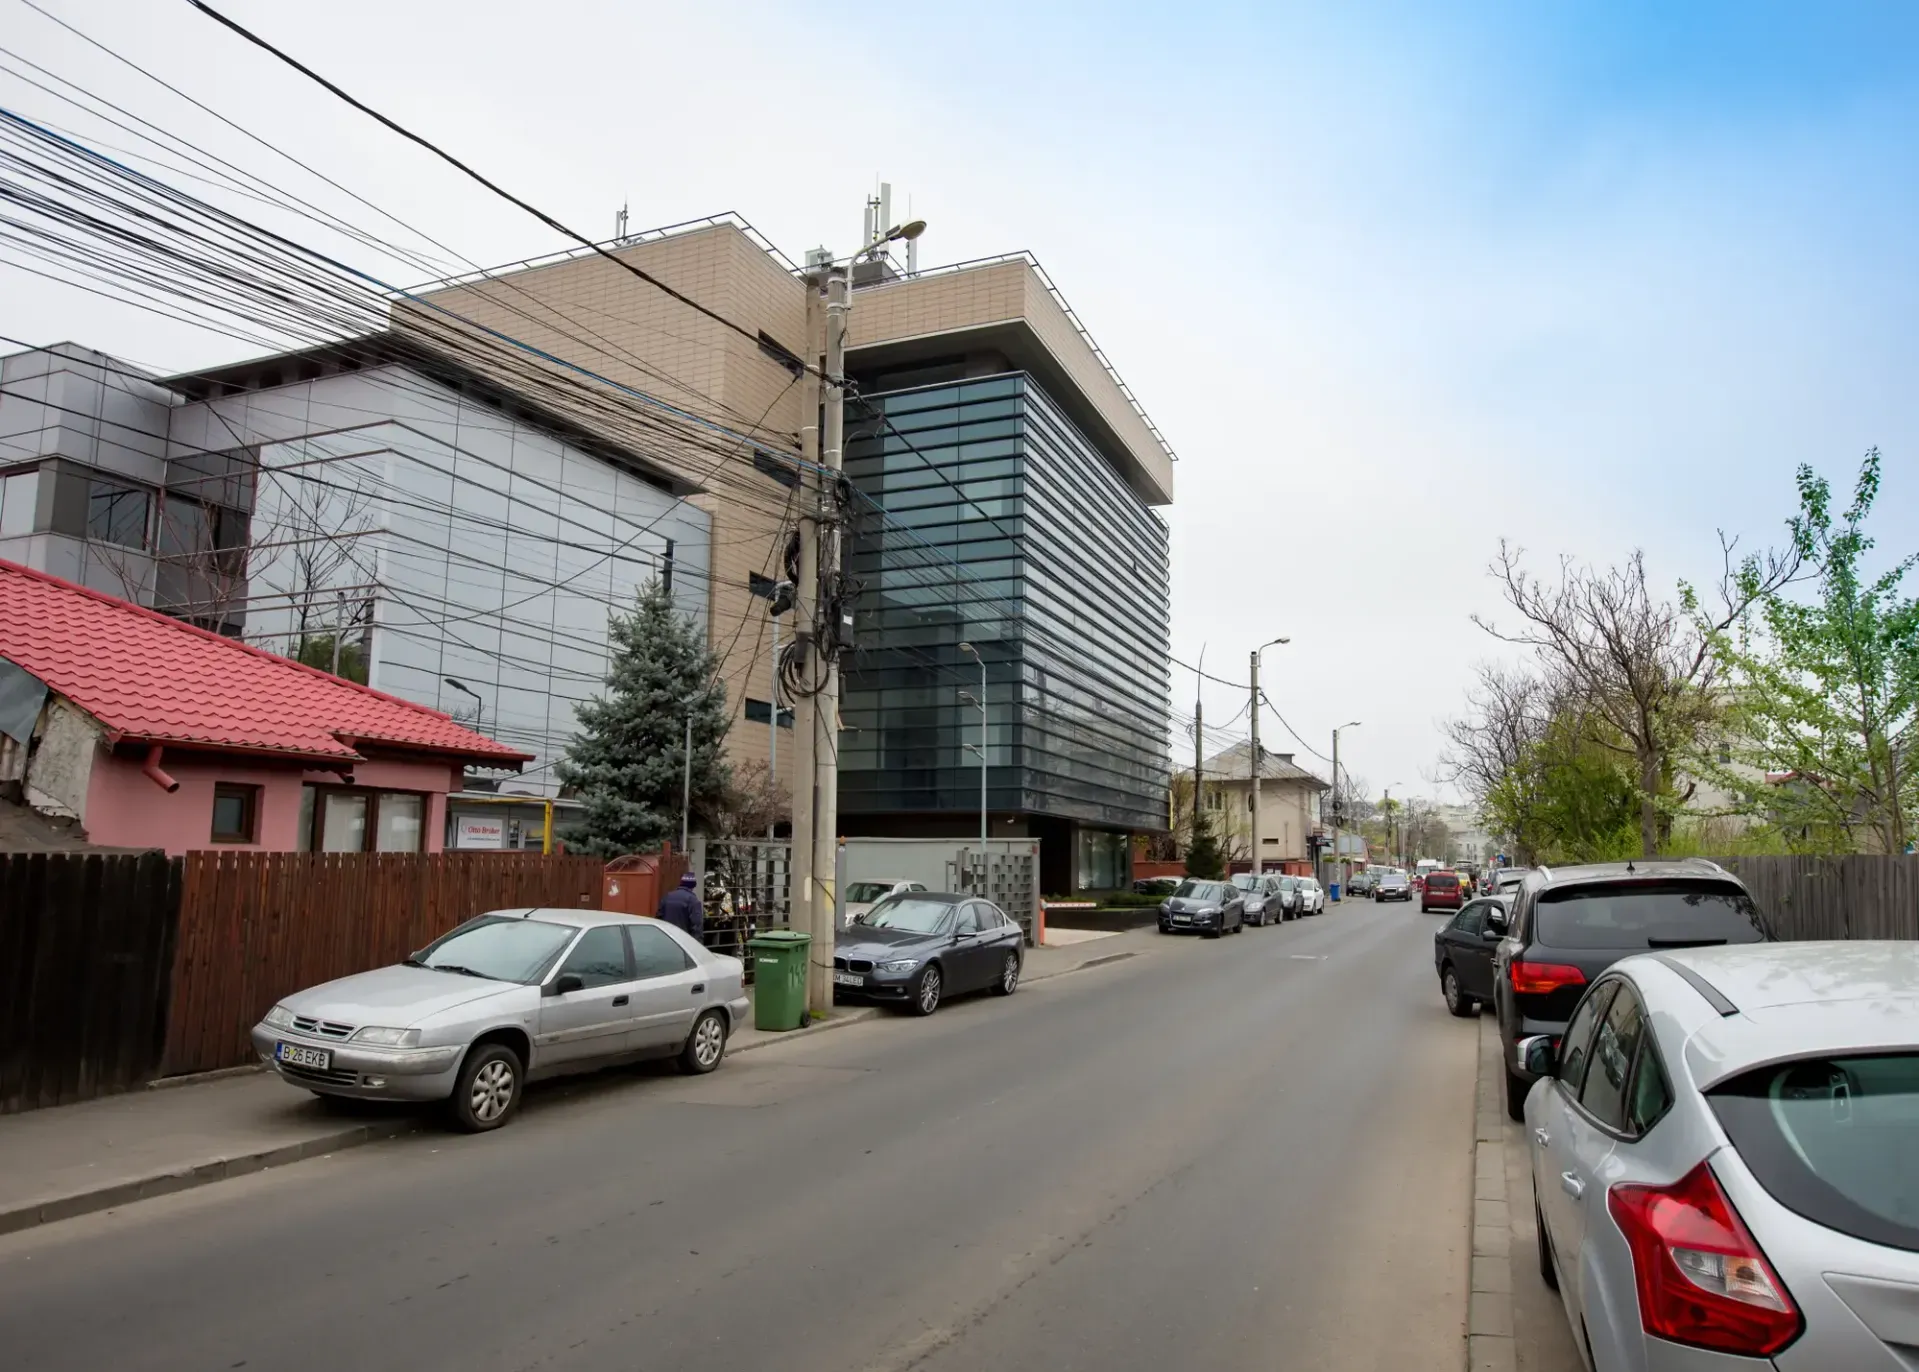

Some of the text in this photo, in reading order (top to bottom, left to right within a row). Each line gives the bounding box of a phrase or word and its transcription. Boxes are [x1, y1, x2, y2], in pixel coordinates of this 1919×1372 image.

[284, 1046, 326, 1067] B 26 EKB
